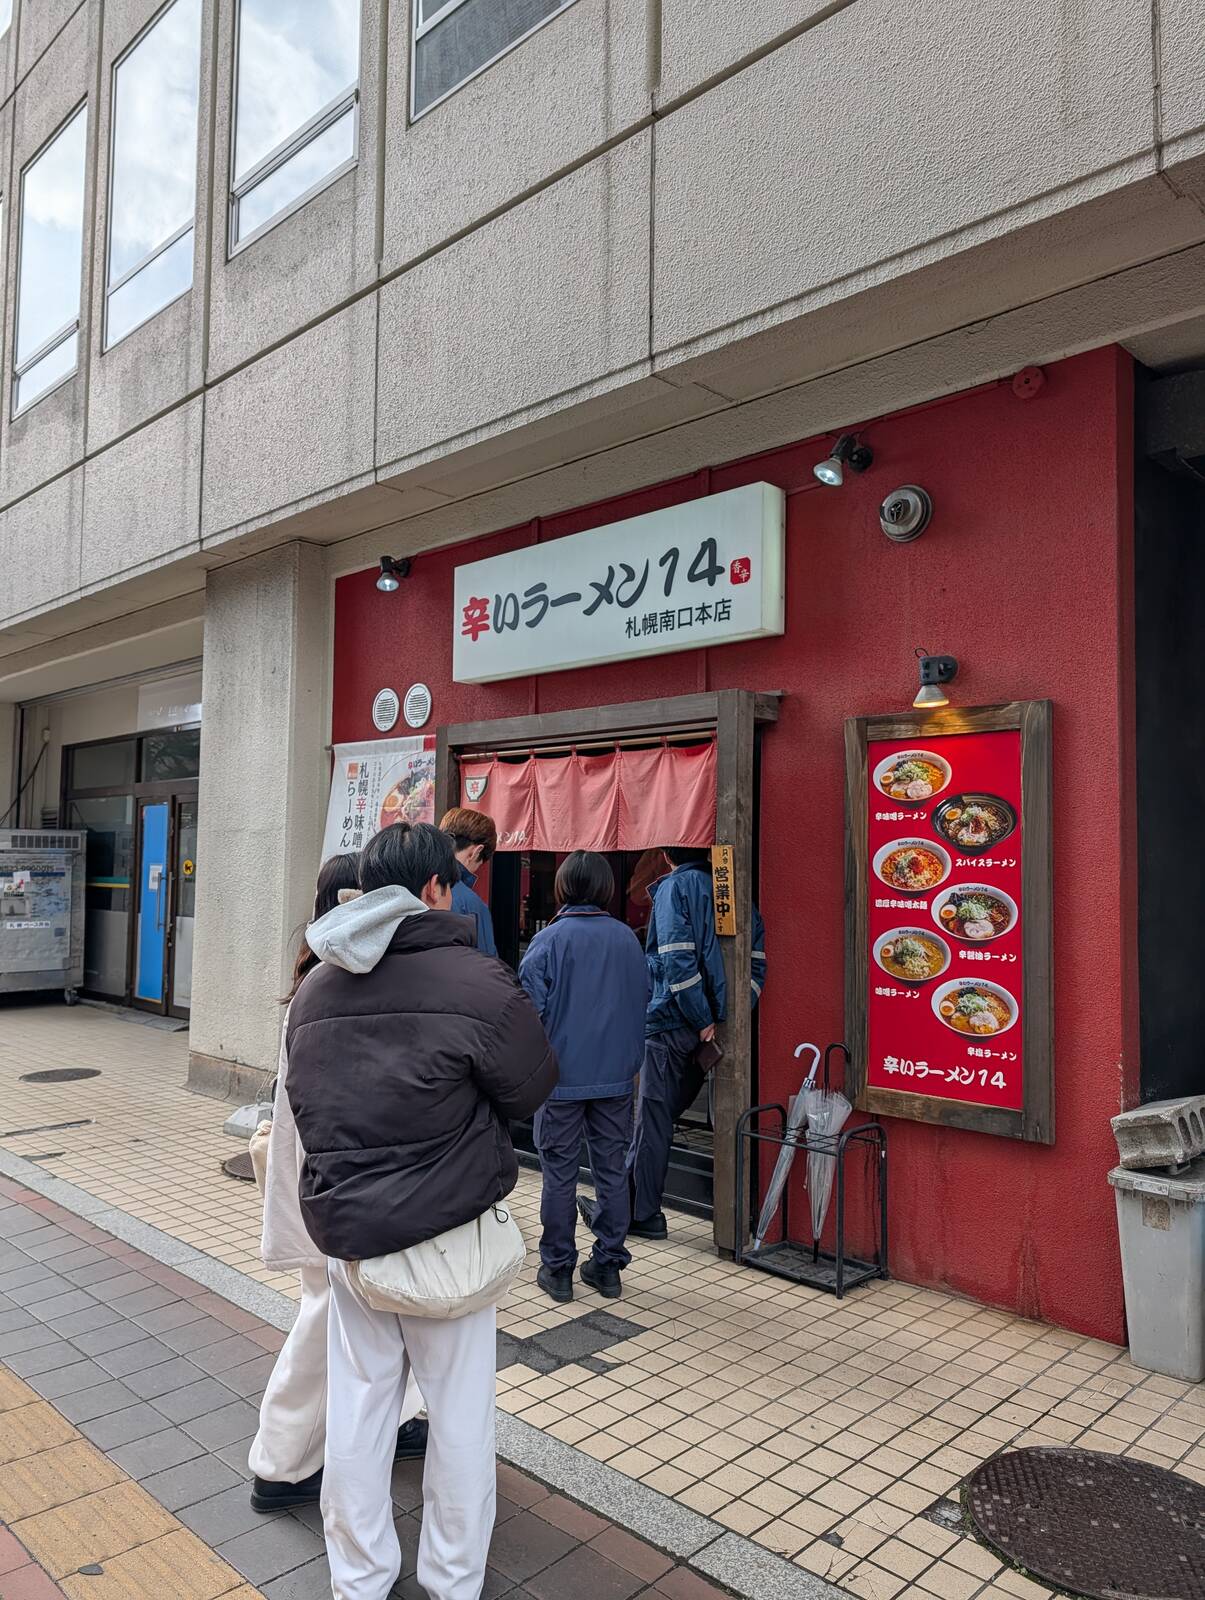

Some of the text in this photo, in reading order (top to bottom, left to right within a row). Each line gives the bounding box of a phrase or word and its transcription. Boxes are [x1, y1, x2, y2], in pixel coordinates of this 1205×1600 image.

[461, 537, 725, 641] 辛いラーメン14
[625, 598, 732, 639] 札幌南口本店
[340, 782, 356, 847] らーめん
[353, 762, 369, 848] 札幌辛味噌
[875, 811, 927, 821] 辛味噌ラーメン
[955, 858, 1016, 867] スパイスラーメン
[959, 950, 1017, 962] 辛醤油ラーメン
[875, 987, 920, 998] 味噌ラーメン
[967, 1046, 1017, 1061] 辛塩ラーメン
[883, 1055, 1007, 1089] 辛いラーメン14
